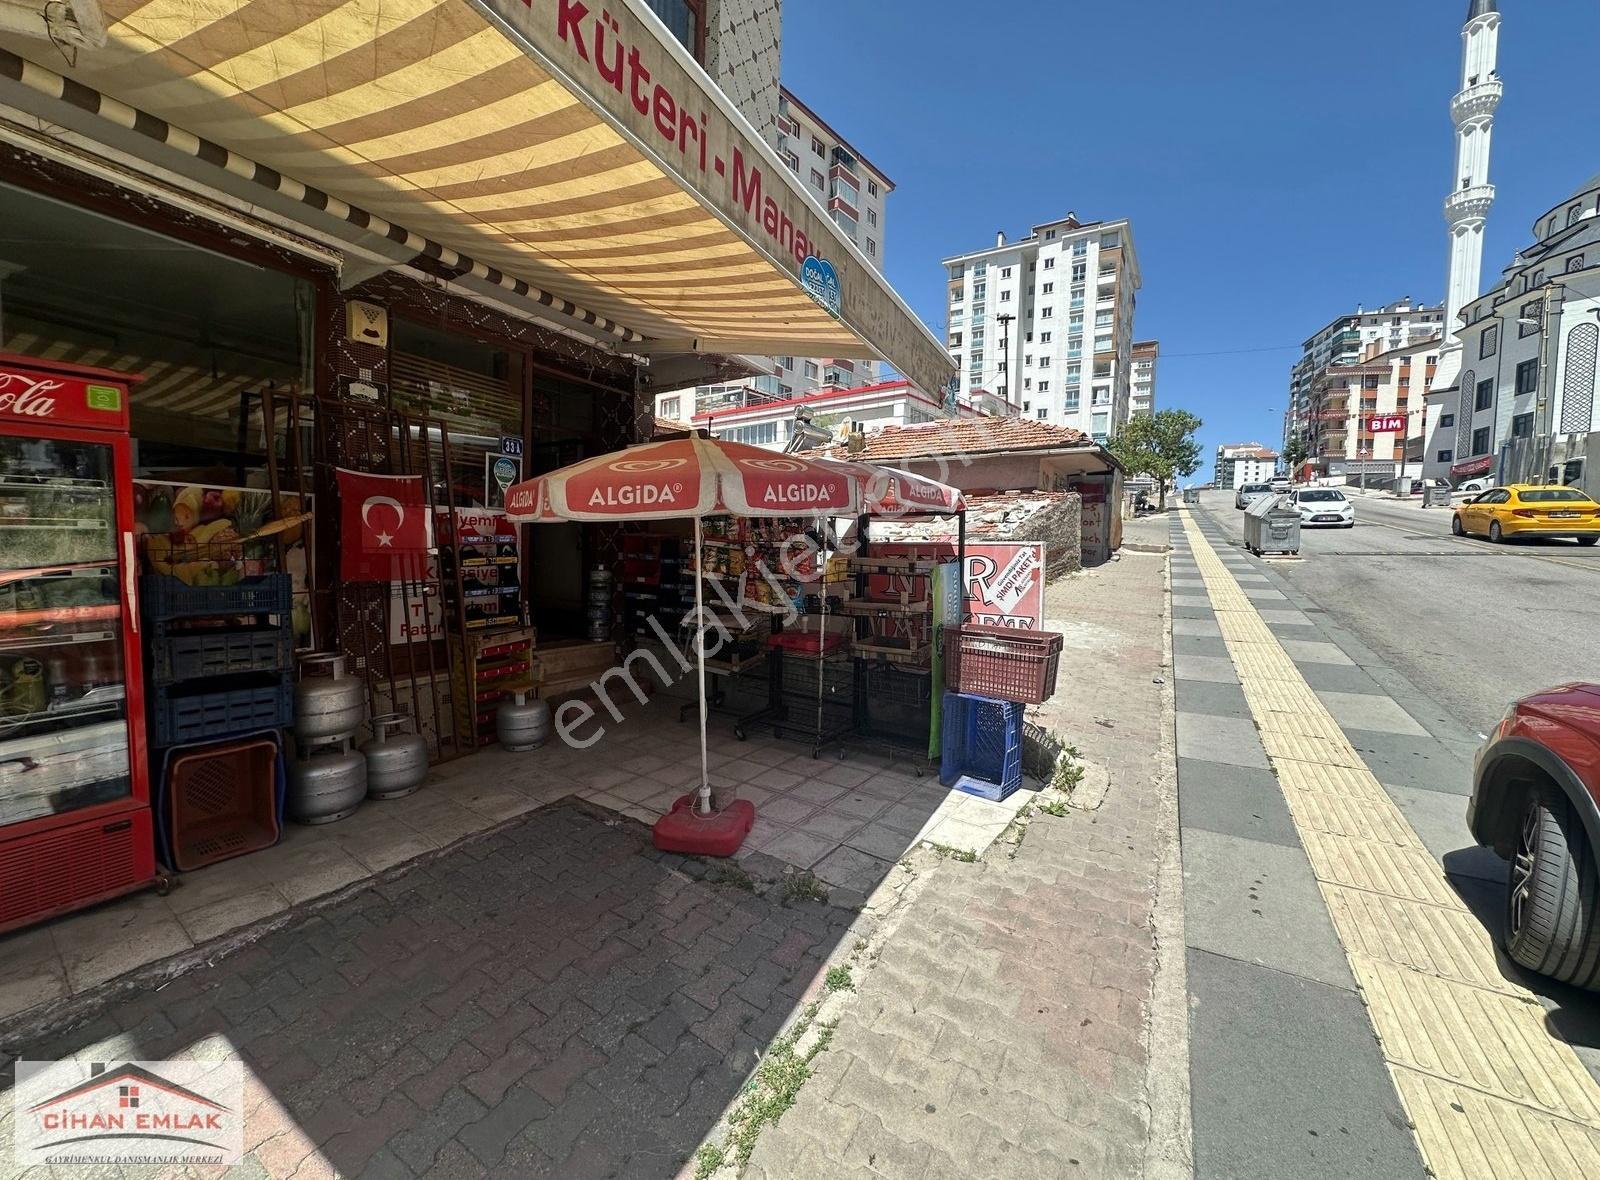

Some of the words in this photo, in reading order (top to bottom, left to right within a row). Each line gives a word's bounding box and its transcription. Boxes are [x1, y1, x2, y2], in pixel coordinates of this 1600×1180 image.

[520, 0, 707, 173] küteri
[1371, 417, 1402, 431] BİM
[880, 554, 998, 606] NR
